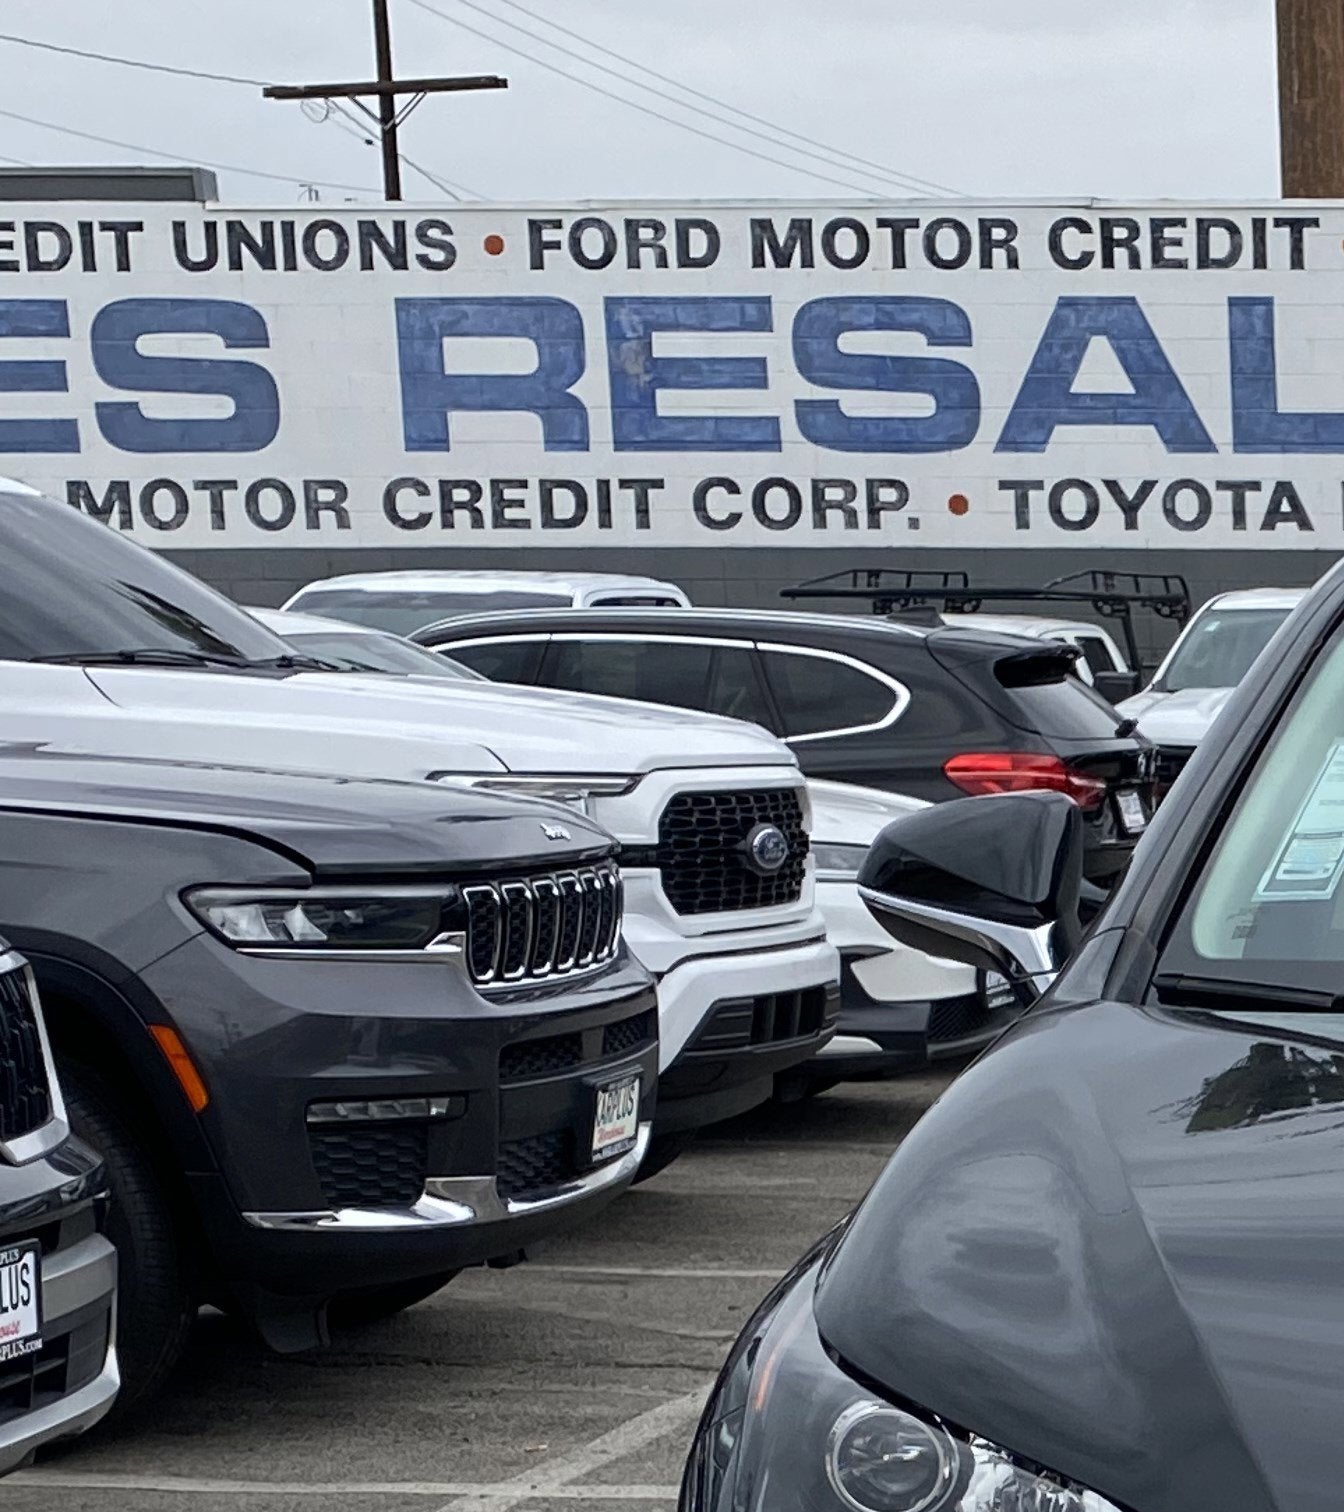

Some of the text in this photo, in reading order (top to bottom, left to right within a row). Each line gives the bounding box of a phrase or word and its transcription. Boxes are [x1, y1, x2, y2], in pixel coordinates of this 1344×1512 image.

[171, 218, 457, 273] UNIONS
[527, 216, 1320, 271] FORD MOTOR CREDIT
[65, 477, 920, 532] MOTOR CREDIT CORP.
[997, 478, 1315, 532] TOYOTA
